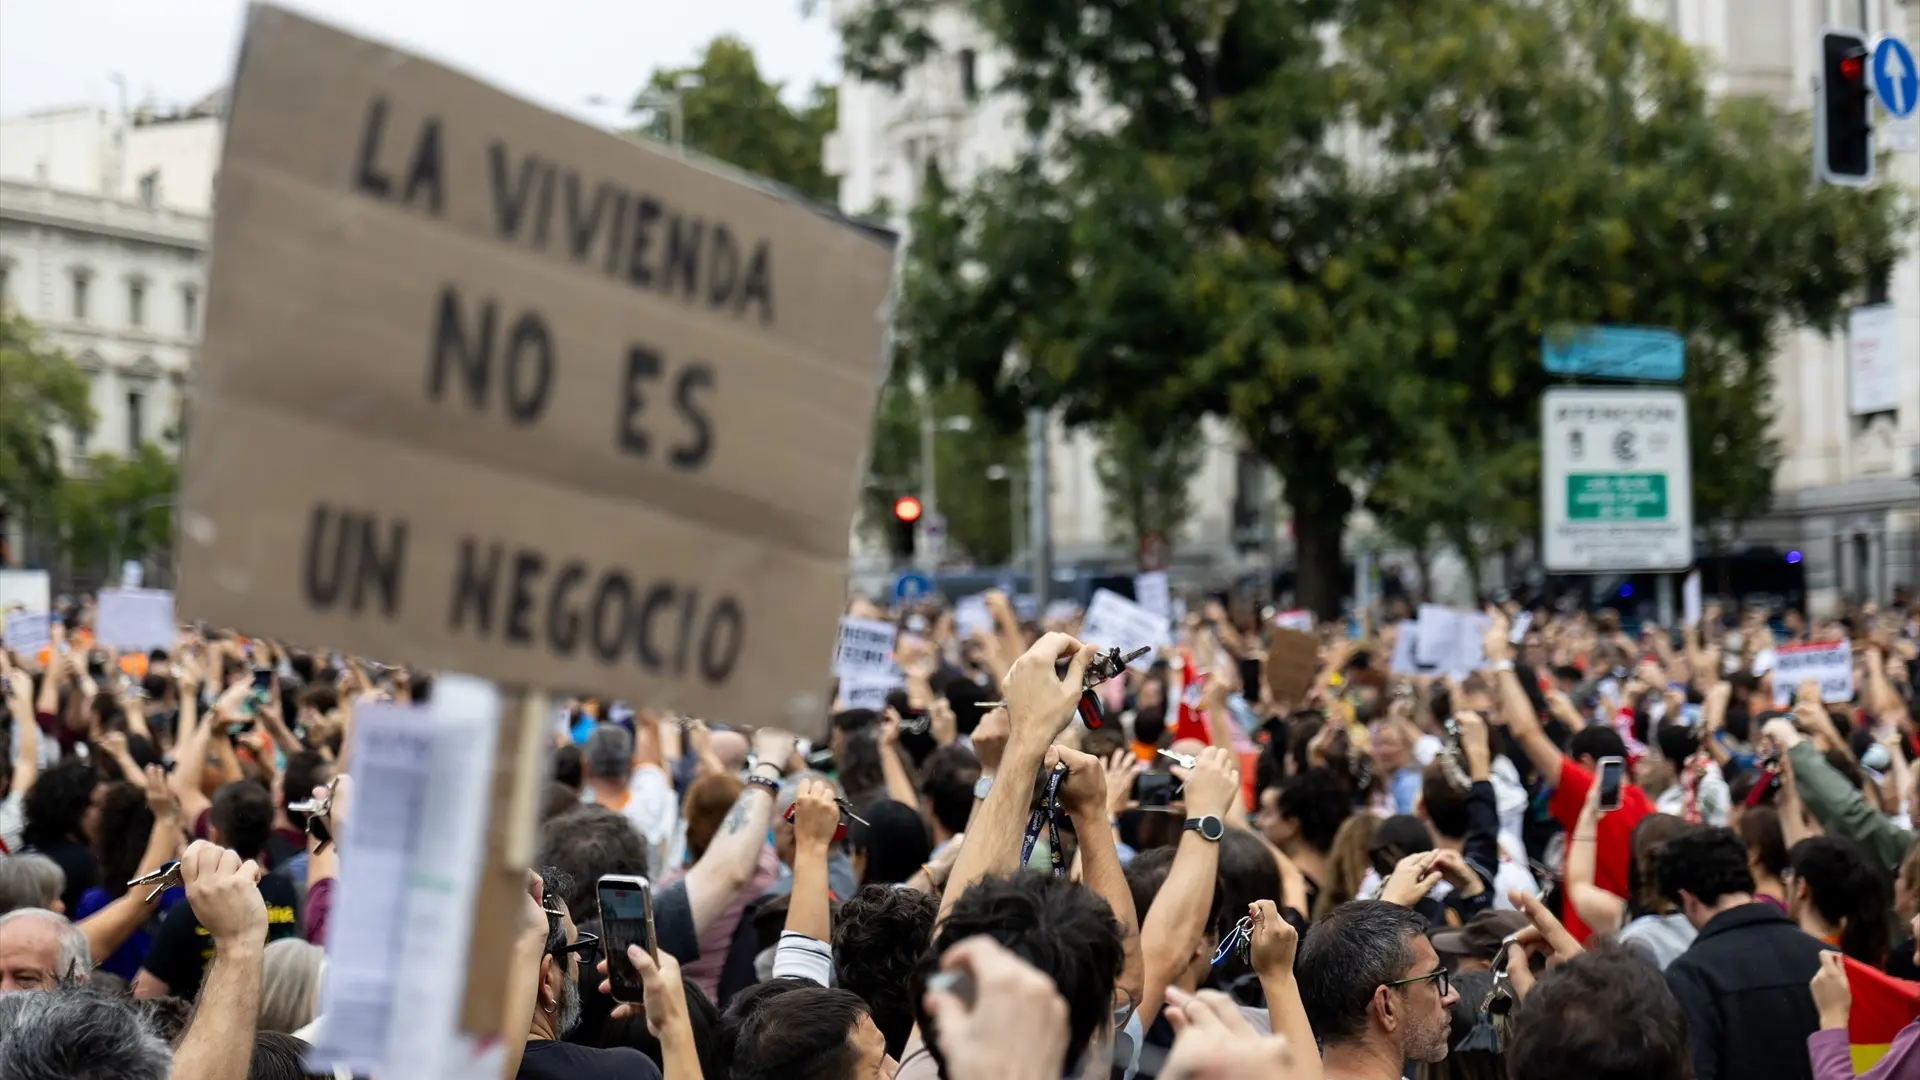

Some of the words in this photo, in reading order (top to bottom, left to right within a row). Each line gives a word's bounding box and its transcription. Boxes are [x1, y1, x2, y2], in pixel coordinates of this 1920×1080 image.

[354, 95, 445, 214] LA
[489, 140, 775, 325] VIVIENDA
[427, 283, 556, 424] NO
[620, 345, 716, 468] ES
[307, 506, 407, 620] UN
[449, 538, 745, 683] NEGOCIO
